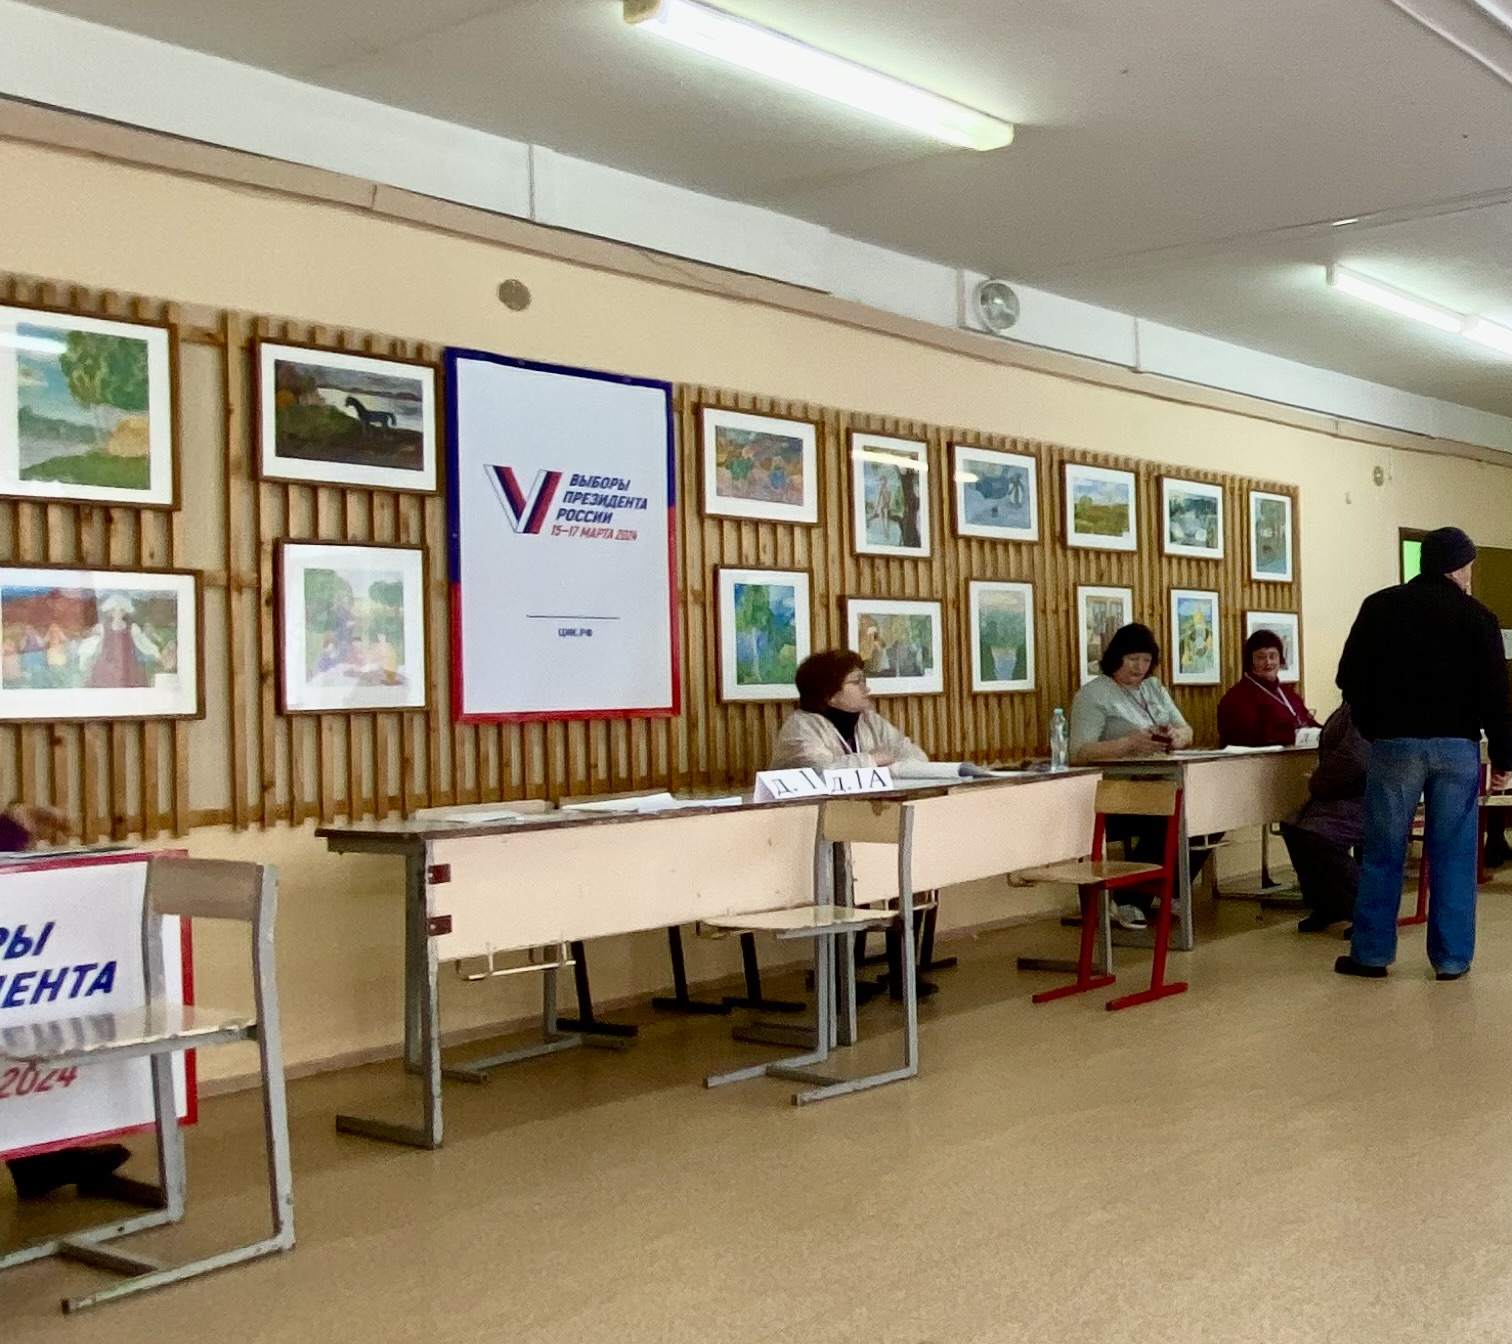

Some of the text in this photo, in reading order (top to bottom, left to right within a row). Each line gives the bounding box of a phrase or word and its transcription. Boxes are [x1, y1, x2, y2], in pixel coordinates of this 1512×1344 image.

[569, 473, 631, 491] ВЫБОРЫ
[562, 490, 648, 510] ПРЕЗИДЕНТА
[556, 507, 614, 524] РОССИИ
[579, 526, 614, 540] МАРТА
[0, 960, 117, 1009] ЕНТА
